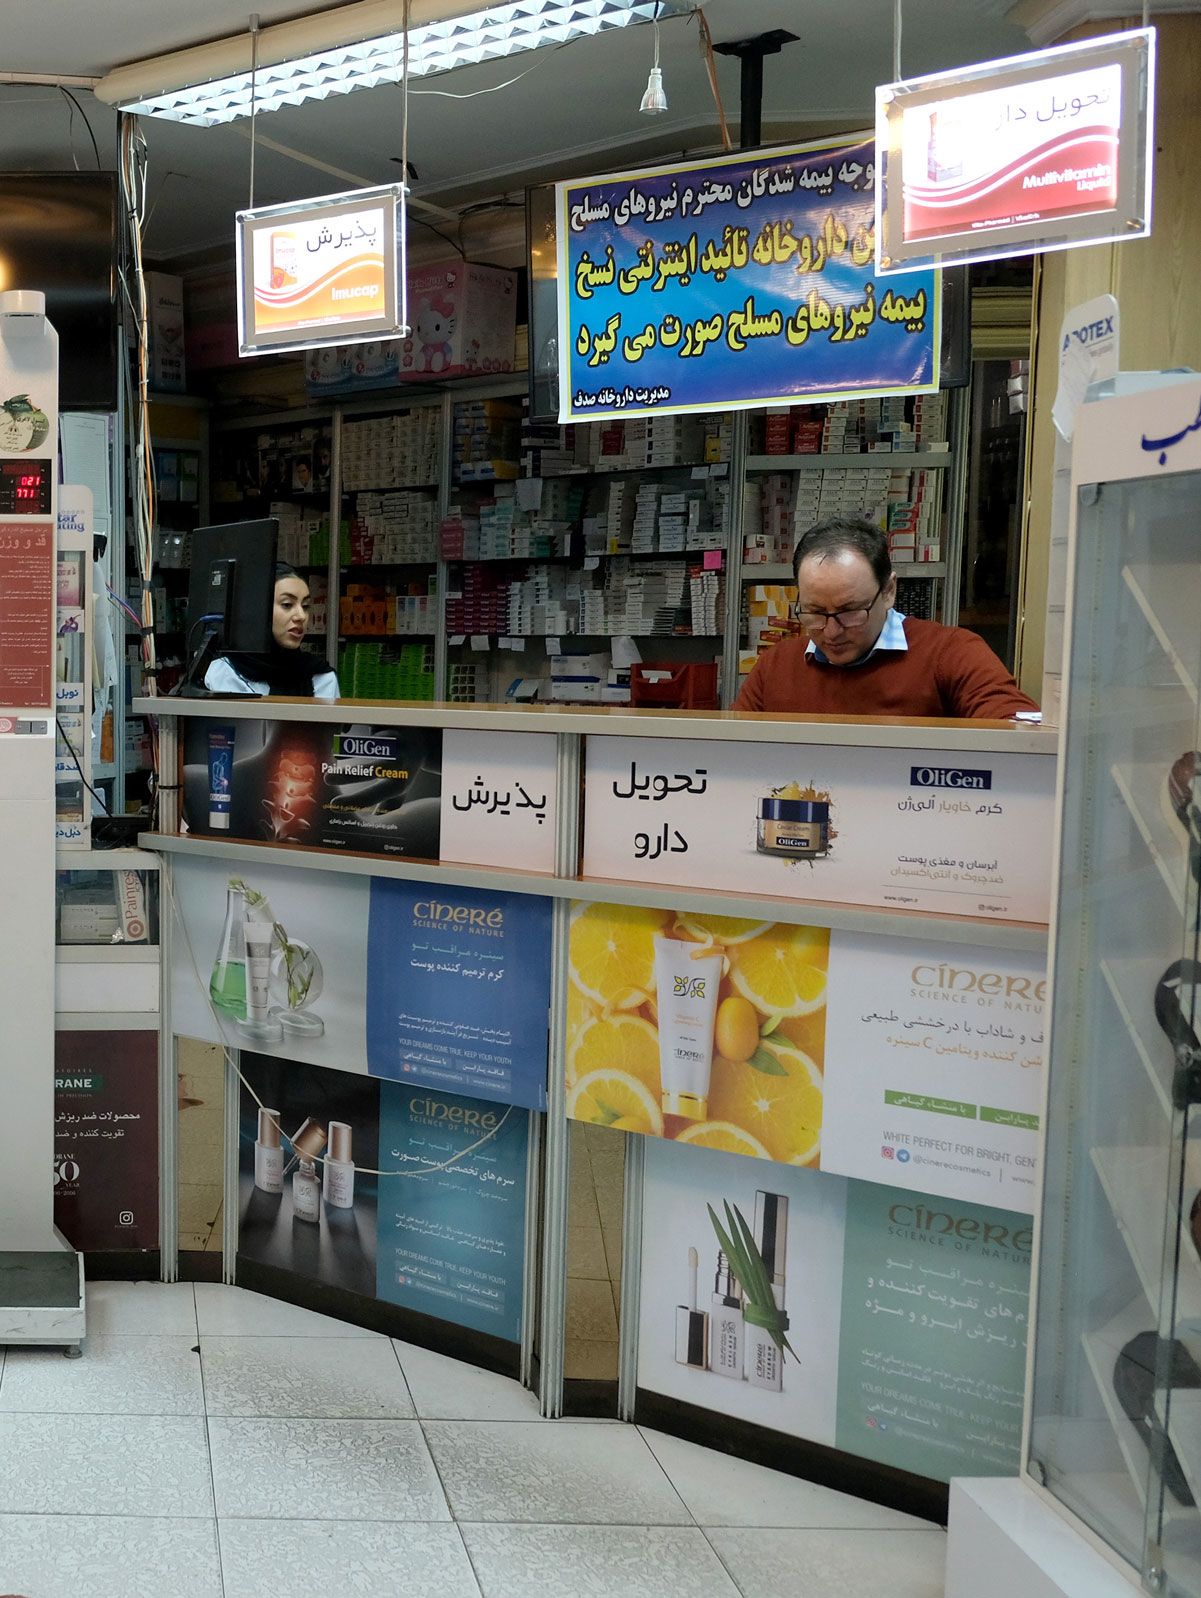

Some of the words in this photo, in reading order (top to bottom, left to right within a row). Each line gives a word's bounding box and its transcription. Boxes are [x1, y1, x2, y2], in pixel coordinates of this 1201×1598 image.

[799, 166, 834, 197] بیمه
[838, 158, 875, 193] وجه
[1022, 163, 1112, 190] Multivitamin
[736, 164, 795, 209] شدگان
[613, 183, 678, 228] نیروهای
[682, 180, 732, 217] محترم
[570, 196, 611, 232] مسلح
[306, 219, 378, 253] پذیرش
[752, 213, 846, 274] داروخانه
[576, 243, 615, 298] نسخ
[619, 235, 698, 296] اینترنتی
[331, 283, 380, 303] Imucap
[786, 282, 875, 346] نیروهای
[880, 286, 926, 331] بیمه
[726, 295, 782, 352] مسلح
[576, 312, 622, 366] گیرد
[660, 311, 723, 358] صورت
[623, 328, 656, 362] می
[572, 390, 597, 408] صدف
[597, 388, 635, 408] داروخانه
[634, 385, 671, 404] مدیریت
[343, 738, 390, 756] OliGen
[321, 761, 343, 776] Pain
[344, 763, 374, 778] Relief
[375, 765, 409, 780] Cream
[917, 766, 986, 789] OliGen
[612, 761, 707, 802] تحویل
[451, 774, 548, 825] پذیرش
[938, 799, 971, 814] خاویار
[975, 803, 1003, 816] کرم
[633, 822, 689, 860] دارو
[778, 837, 809, 847] OliGen
[897, 854, 927, 866] پوست
[929, 857, 956, 868] مغذی
[412, 918, 448, 933] SCIENCE
[468, 925, 505, 939] NATURE
[410, 958, 434, 972] پوست
[437, 962, 461, 973] کننده
[461, 967, 486, 980] ترمیم
[487, 968, 505, 982] کرم
[910, 988, 969, 1006] SCIENCE
[977, 996, 994, 1009] OF
[861, 1009, 899, 1025] طبیعی
[903, 1018, 960, 1035] درخششی
[963, 1021, 972, 1033] با
[887, 1035, 921, 1047] سینره
[923, 1036, 932, 1049] C
[976, 1024, 1015, 1041] شاداب
[412, 1039, 433, 1051] DREAMS
[463, 1048, 478, 1058] KEEP
[478, 1050, 493, 1061] YOUR
[493, 1053, 511, 1065] YOUTH
[936, 1043, 980, 1059] ویتامین
[893, 1095, 924, 1108] گیاهی
[81, 1112, 96, 1121] ضد
[99, 1111, 141, 1122] محصولات
[409, 1115, 443, 1129] SCIENCE
[101, 1128, 125, 1139] تقویت
[882, 1130, 911, 1145] WHITE
[912, 1134, 953, 1152] PERFECT
[954, 1144, 974, 1156] FOR
[391, 1147, 421, 1162] صورت
[444, 1166, 479, 1178] تخصصی
[478, 1170, 495, 1182] های
[912, 1154, 991, 1178] @cinerecosmetics
[495, 1176, 516, 1187] سرم
[887, 1226, 944, 1248] SCIENCE
[954, 1241, 972, 1252] OF
[878, 1278, 926, 1298] کننده
[864, 1299, 904, 1318] مژه
[927, 1288, 979, 1311] تقویت
[920, 1312, 963, 1334] ابرو
